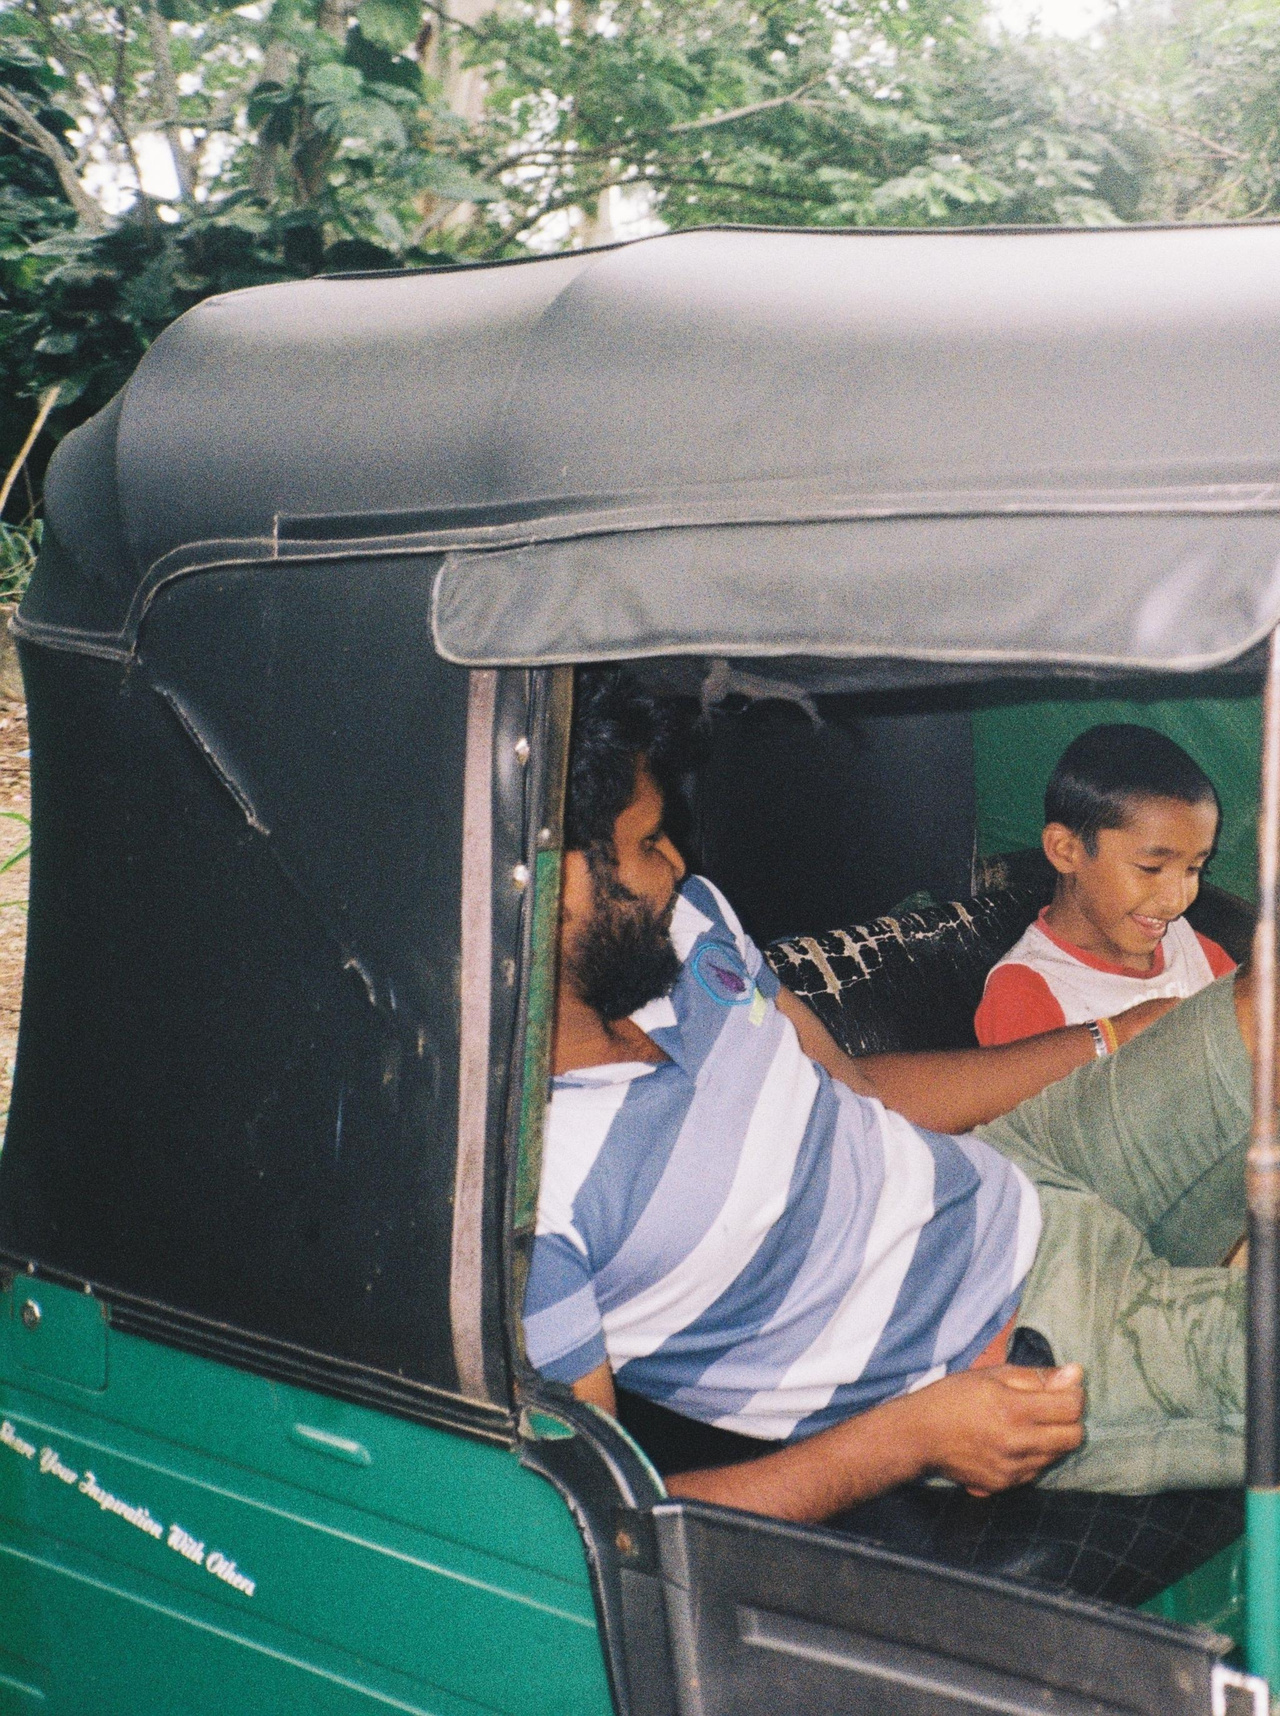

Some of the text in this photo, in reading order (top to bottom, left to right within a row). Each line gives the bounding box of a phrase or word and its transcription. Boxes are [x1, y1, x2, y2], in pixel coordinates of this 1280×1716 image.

[40, 1447, 78, 1484] Your
[79, 1471, 163, 1539] Inspiration
[167, 1524, 205, 1565] With
